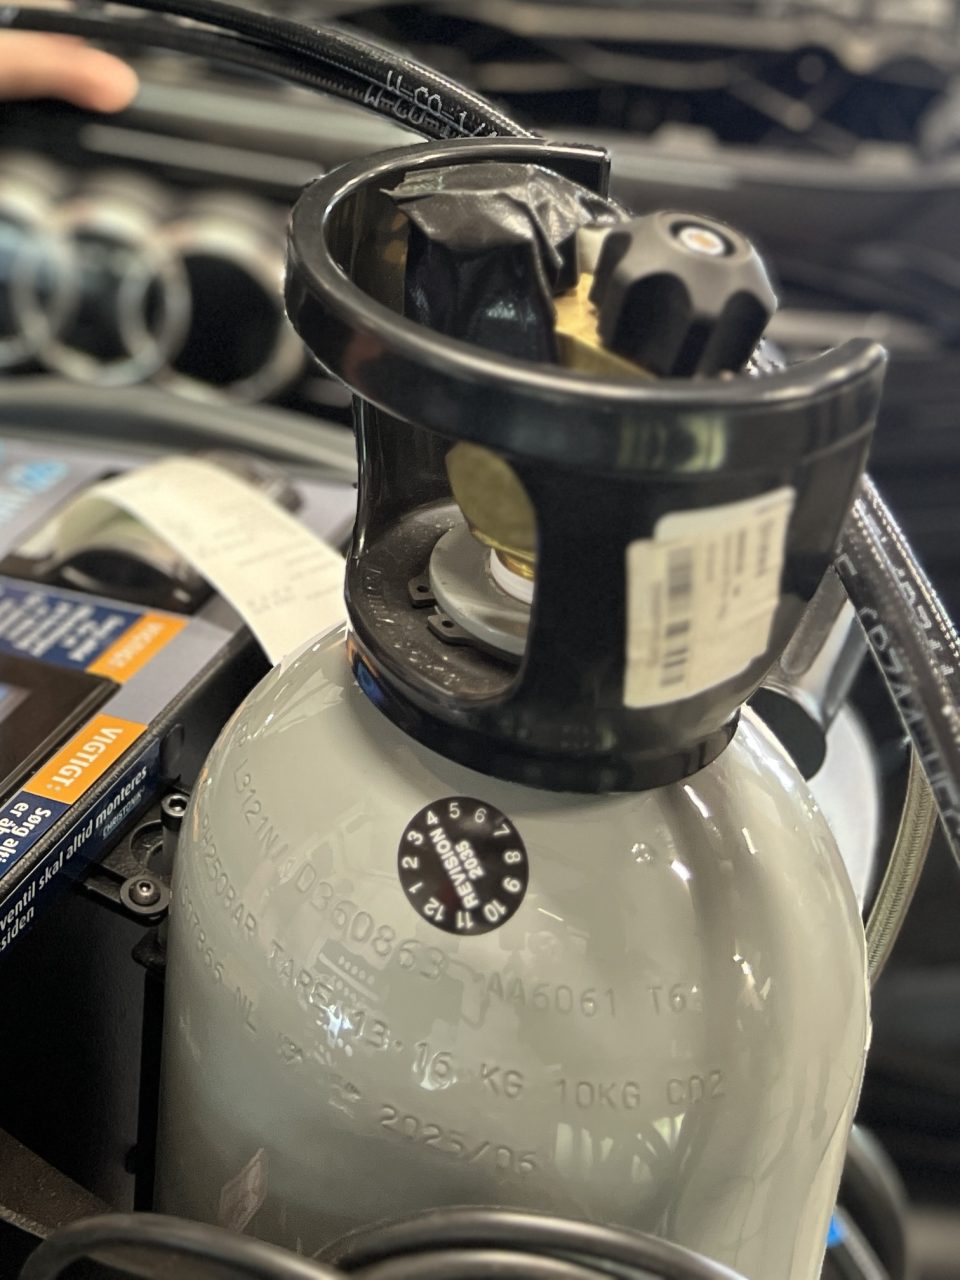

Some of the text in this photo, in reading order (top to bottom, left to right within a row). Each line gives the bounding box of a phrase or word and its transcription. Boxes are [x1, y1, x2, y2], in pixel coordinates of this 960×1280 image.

[9, 802, 29, 818] er
[426, 810, 439, 825] 4
[448, 802, 461, 819] 5
[474, 808, 487, 823] 6
[12, 807, 52, 838] Sørg
[38, 851, 63, 890] skal
[66, 819, 93, 861] altid
[95, 766, 148, 829] monteres
[493, 823, 511, 837] 7
[406, 830, 424, 845] 3
[401, 856, 418, 869] 2
[455, 840, 485, 880] 2035
[504, 850, 521, 865] 8
[429, 827, 479, 909] REVISION
[408, 882, 423, 894] 1
[503, 877, 521, 893] 9
[423, 897, 445, 921] 12
[483, 899, 507, 922] 10
[456, 911, 475, 929] 11
[486, 971, 618, 1018] AA6061
[480, 1063, 524, 1099] KG
[555, 1078, 641, 1111] 10KG
[380, 1104, 537, 1172] 2025/06
